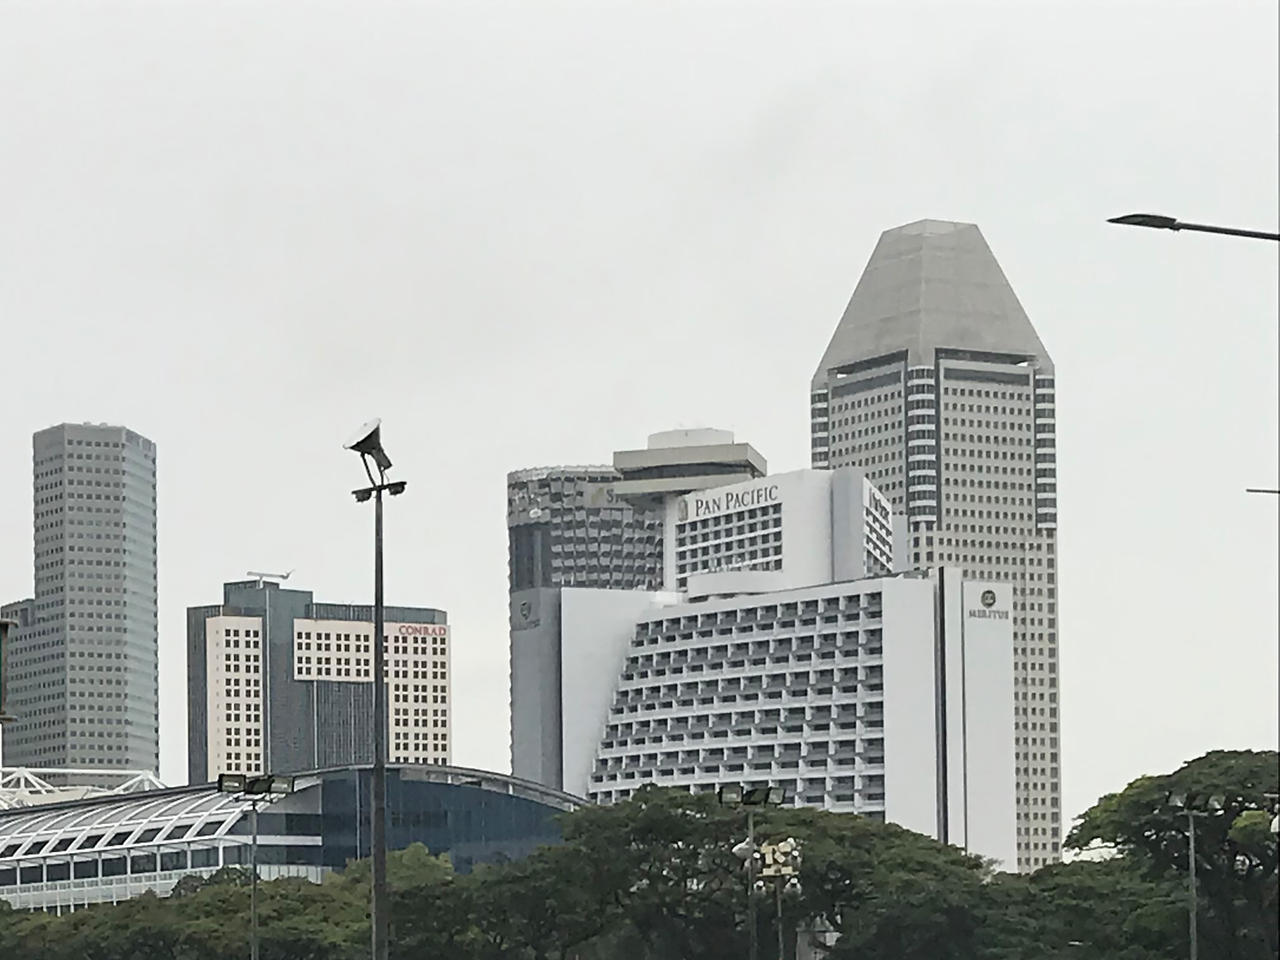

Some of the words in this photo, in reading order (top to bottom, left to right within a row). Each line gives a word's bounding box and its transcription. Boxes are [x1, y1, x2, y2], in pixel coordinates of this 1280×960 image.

[695, 497, 721, 517] PAN
[725, 485, 778, 510] PACIFIC
[399, 625, 447, 636] CONRAD
